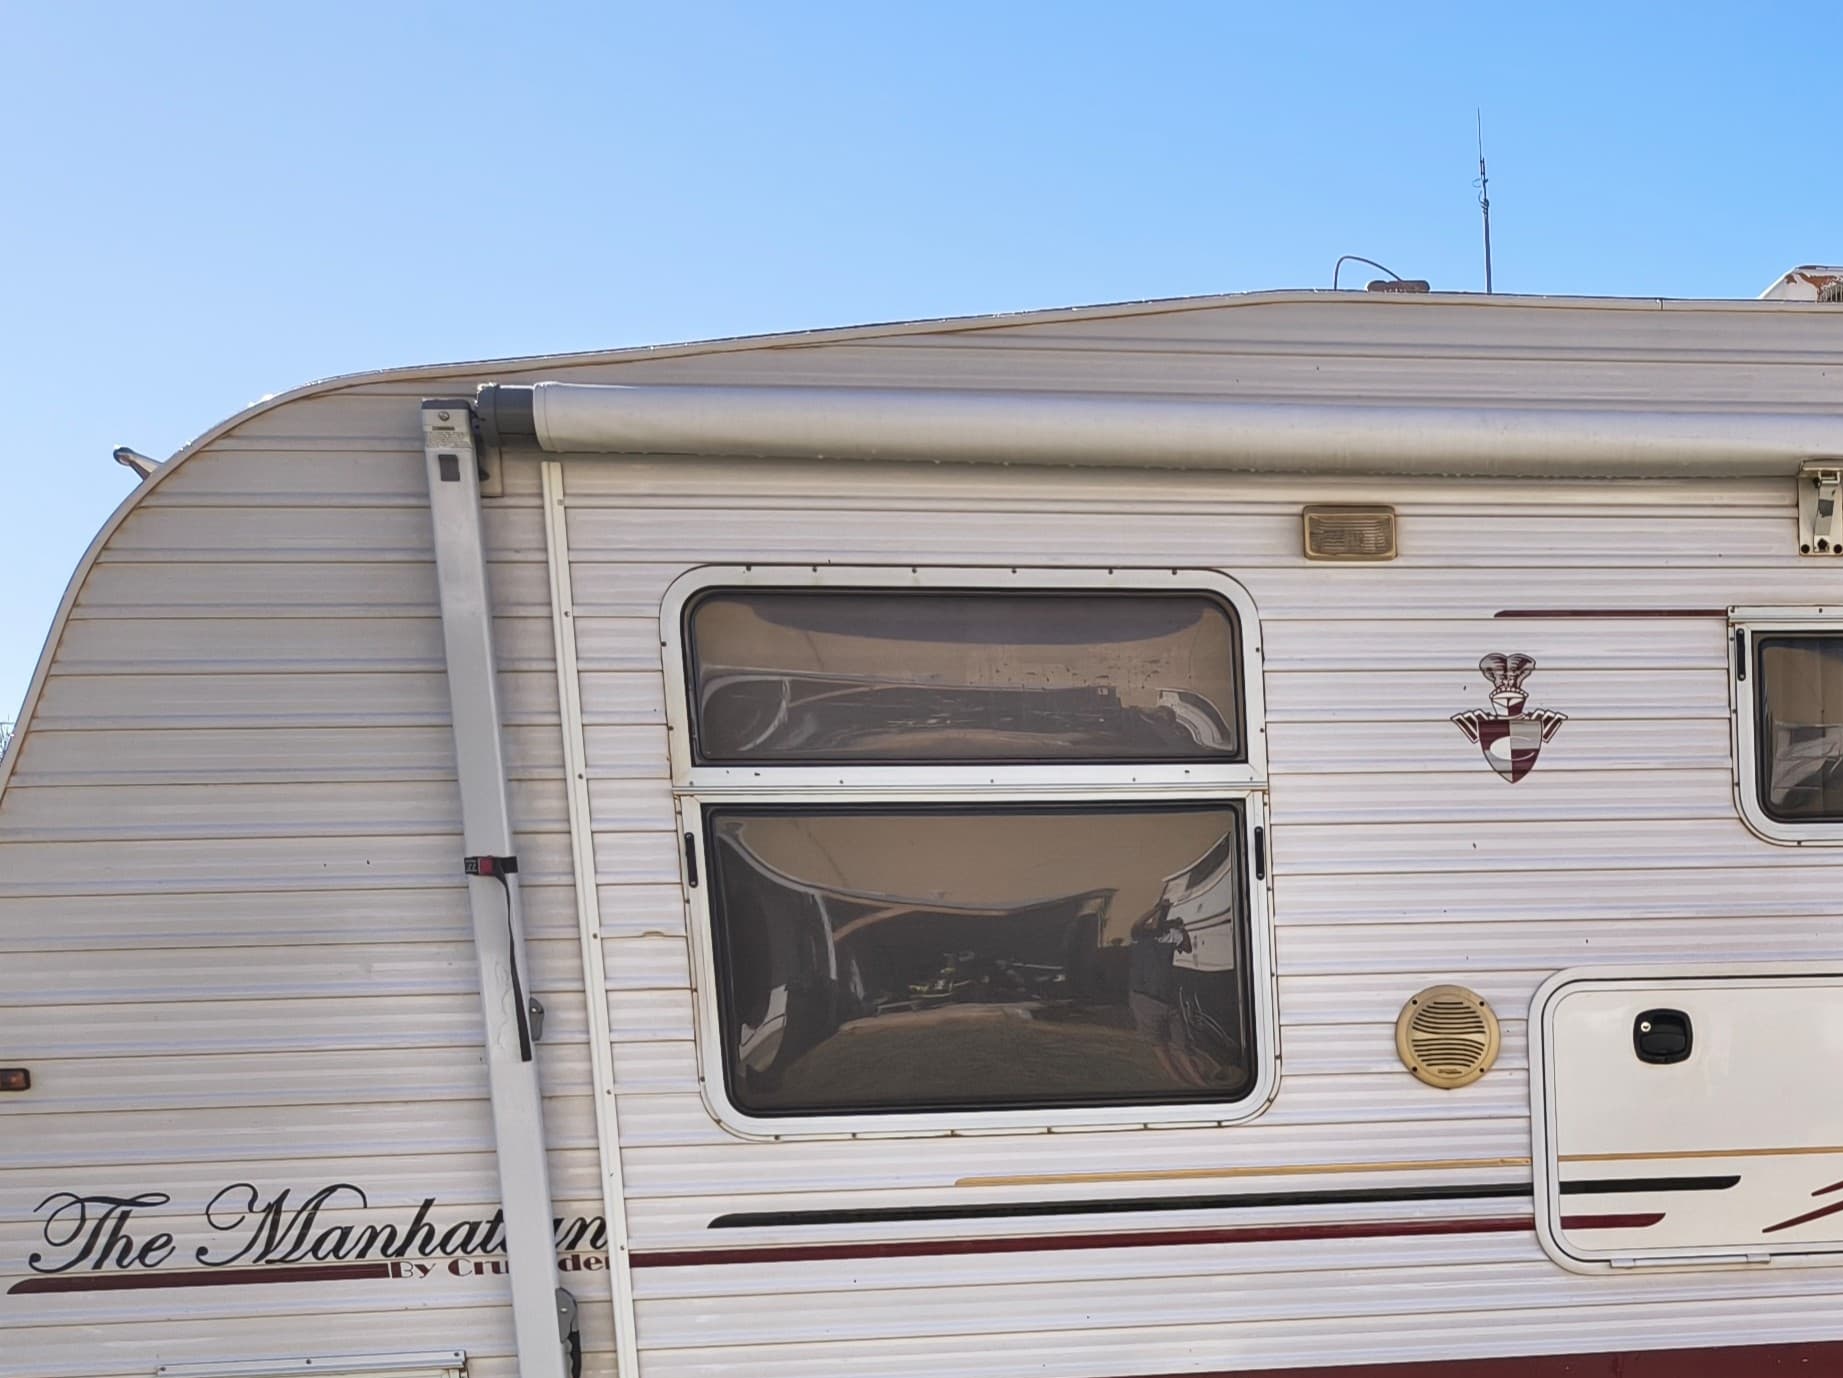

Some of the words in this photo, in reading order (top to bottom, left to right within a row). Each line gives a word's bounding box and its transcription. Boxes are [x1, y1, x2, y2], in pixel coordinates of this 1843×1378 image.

[29, 1191, 176, 1274] The
[195, 1182, 609, 1267] Manhatn
[391, 1260, 436, 1279] By
[447, 1252, 609, 1277] Crude
